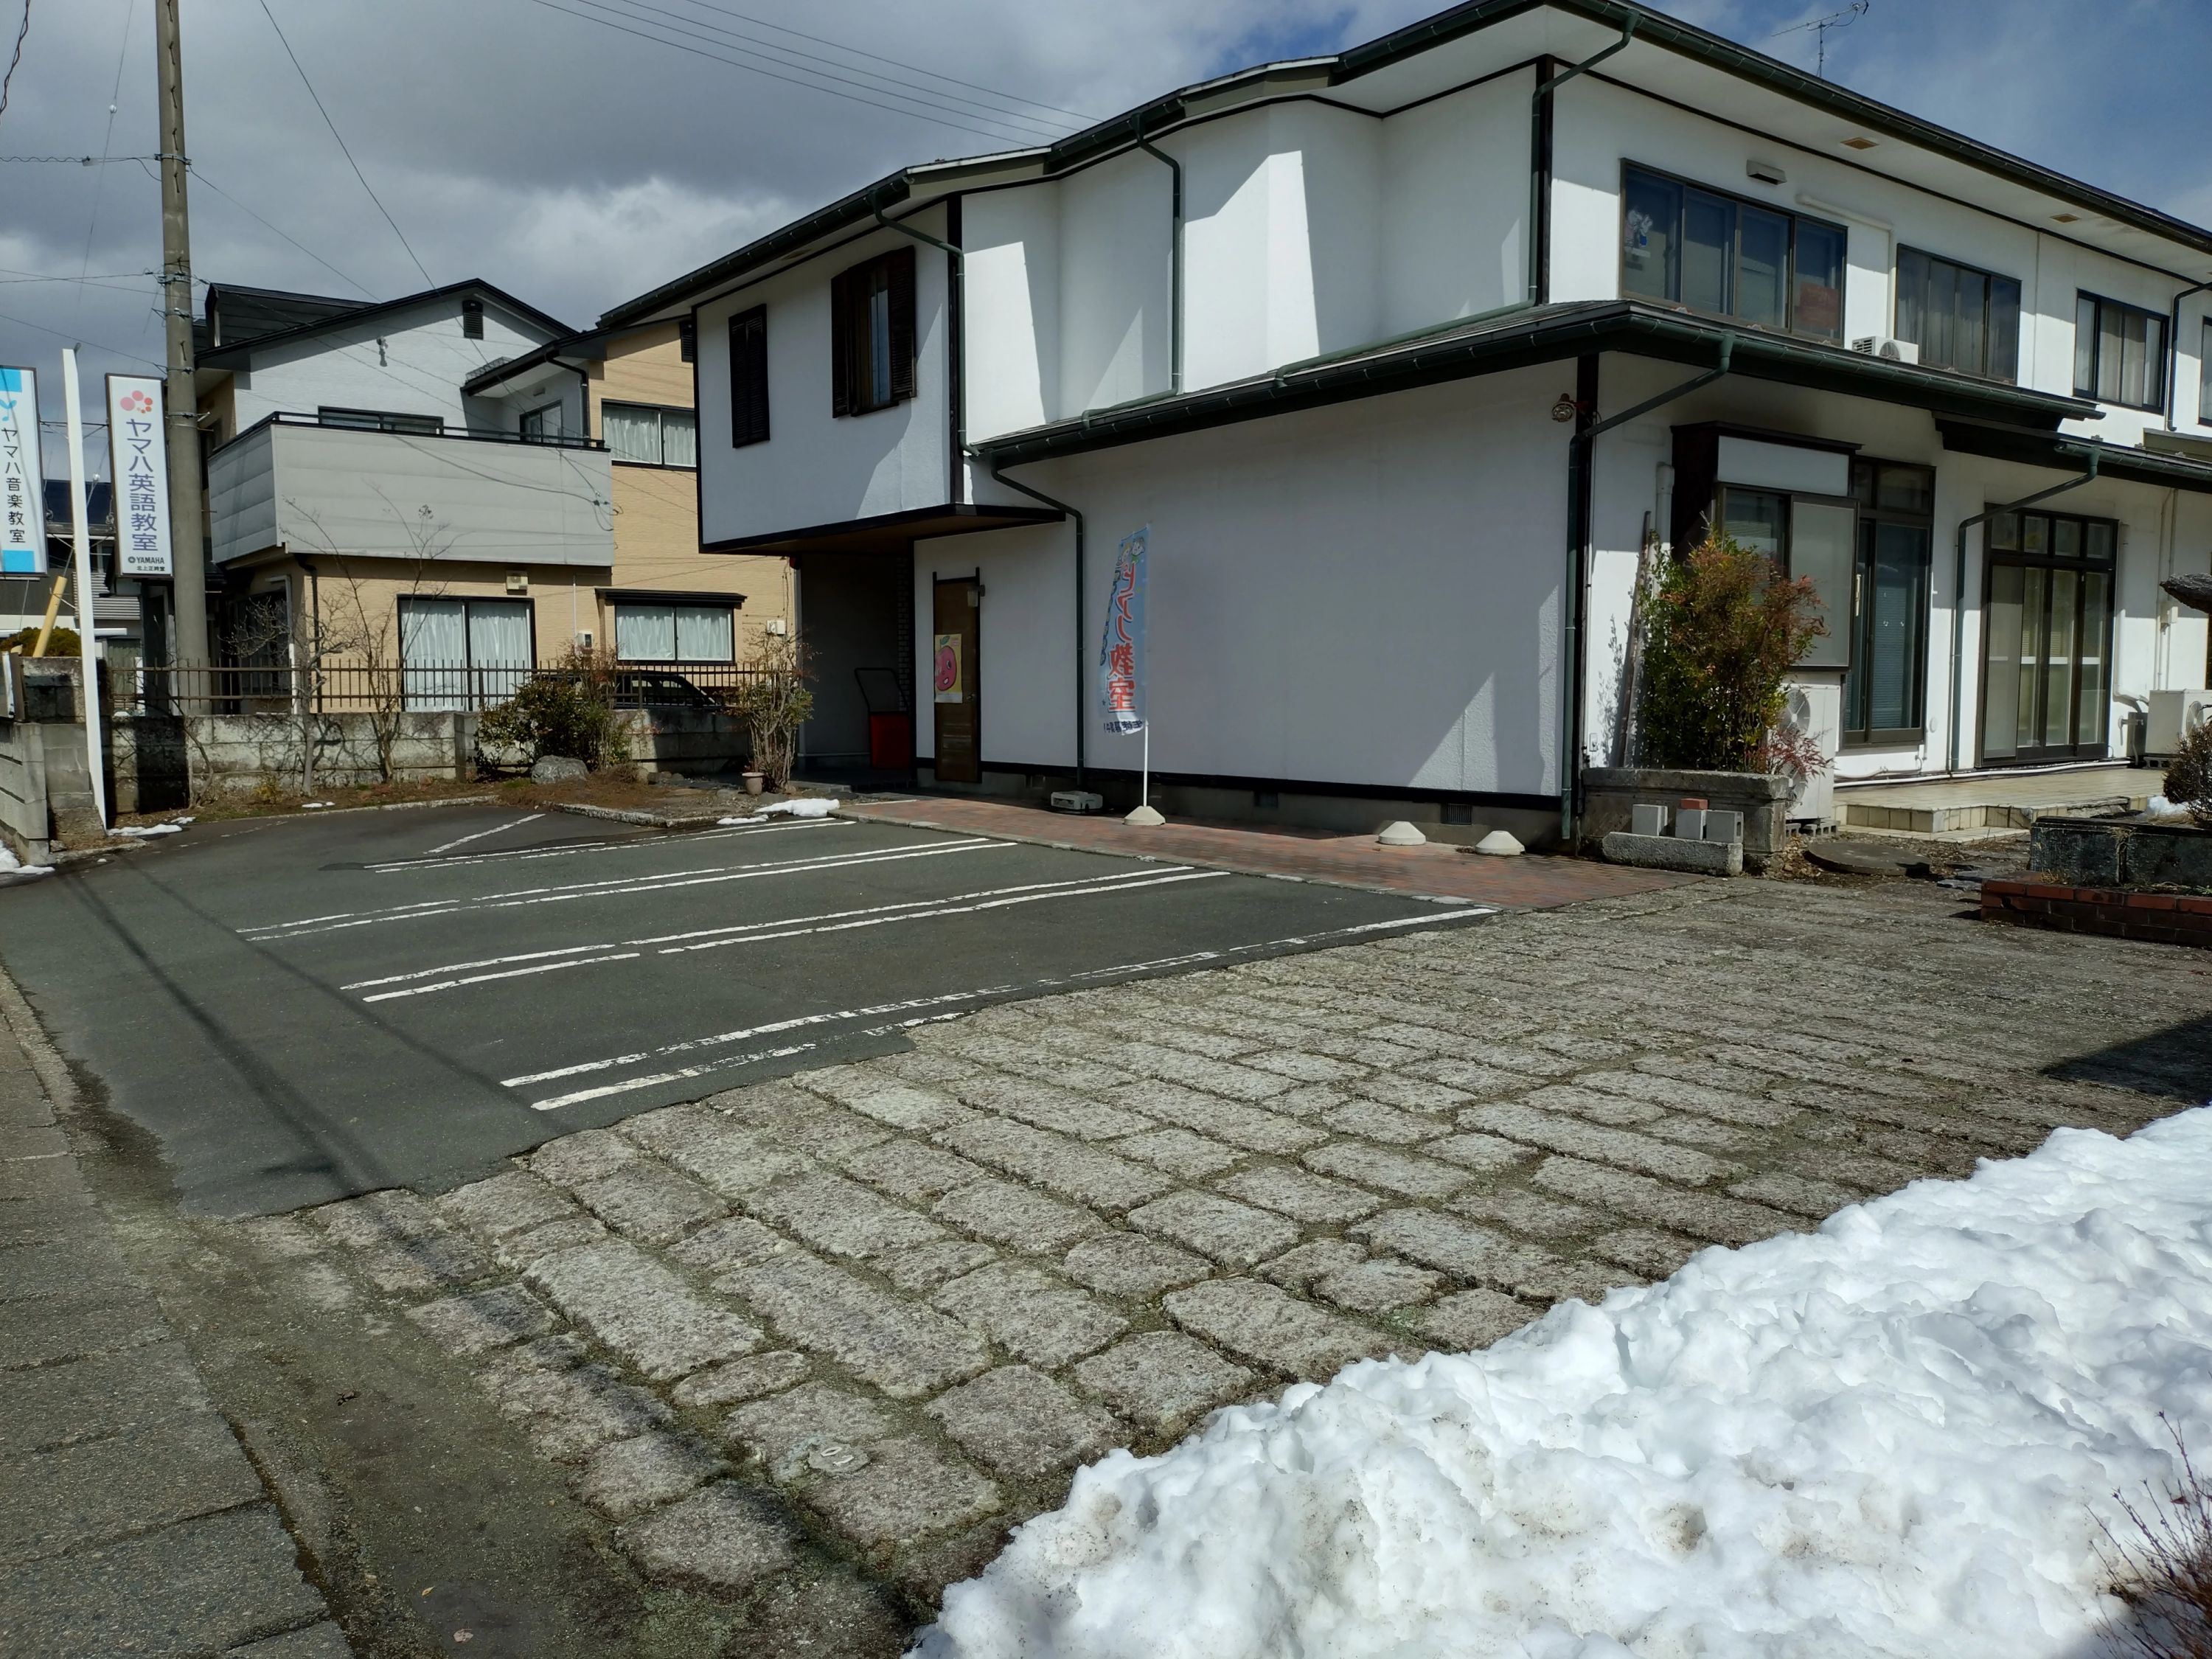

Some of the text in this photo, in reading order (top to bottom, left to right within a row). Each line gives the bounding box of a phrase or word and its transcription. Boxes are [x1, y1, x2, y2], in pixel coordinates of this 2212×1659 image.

[1, 427, 27, 543] ヤマハ音楽教室
[126, 418, 158, 552] ヤマハ英語教室
[136, 556, 164, 564] YAMAHA
